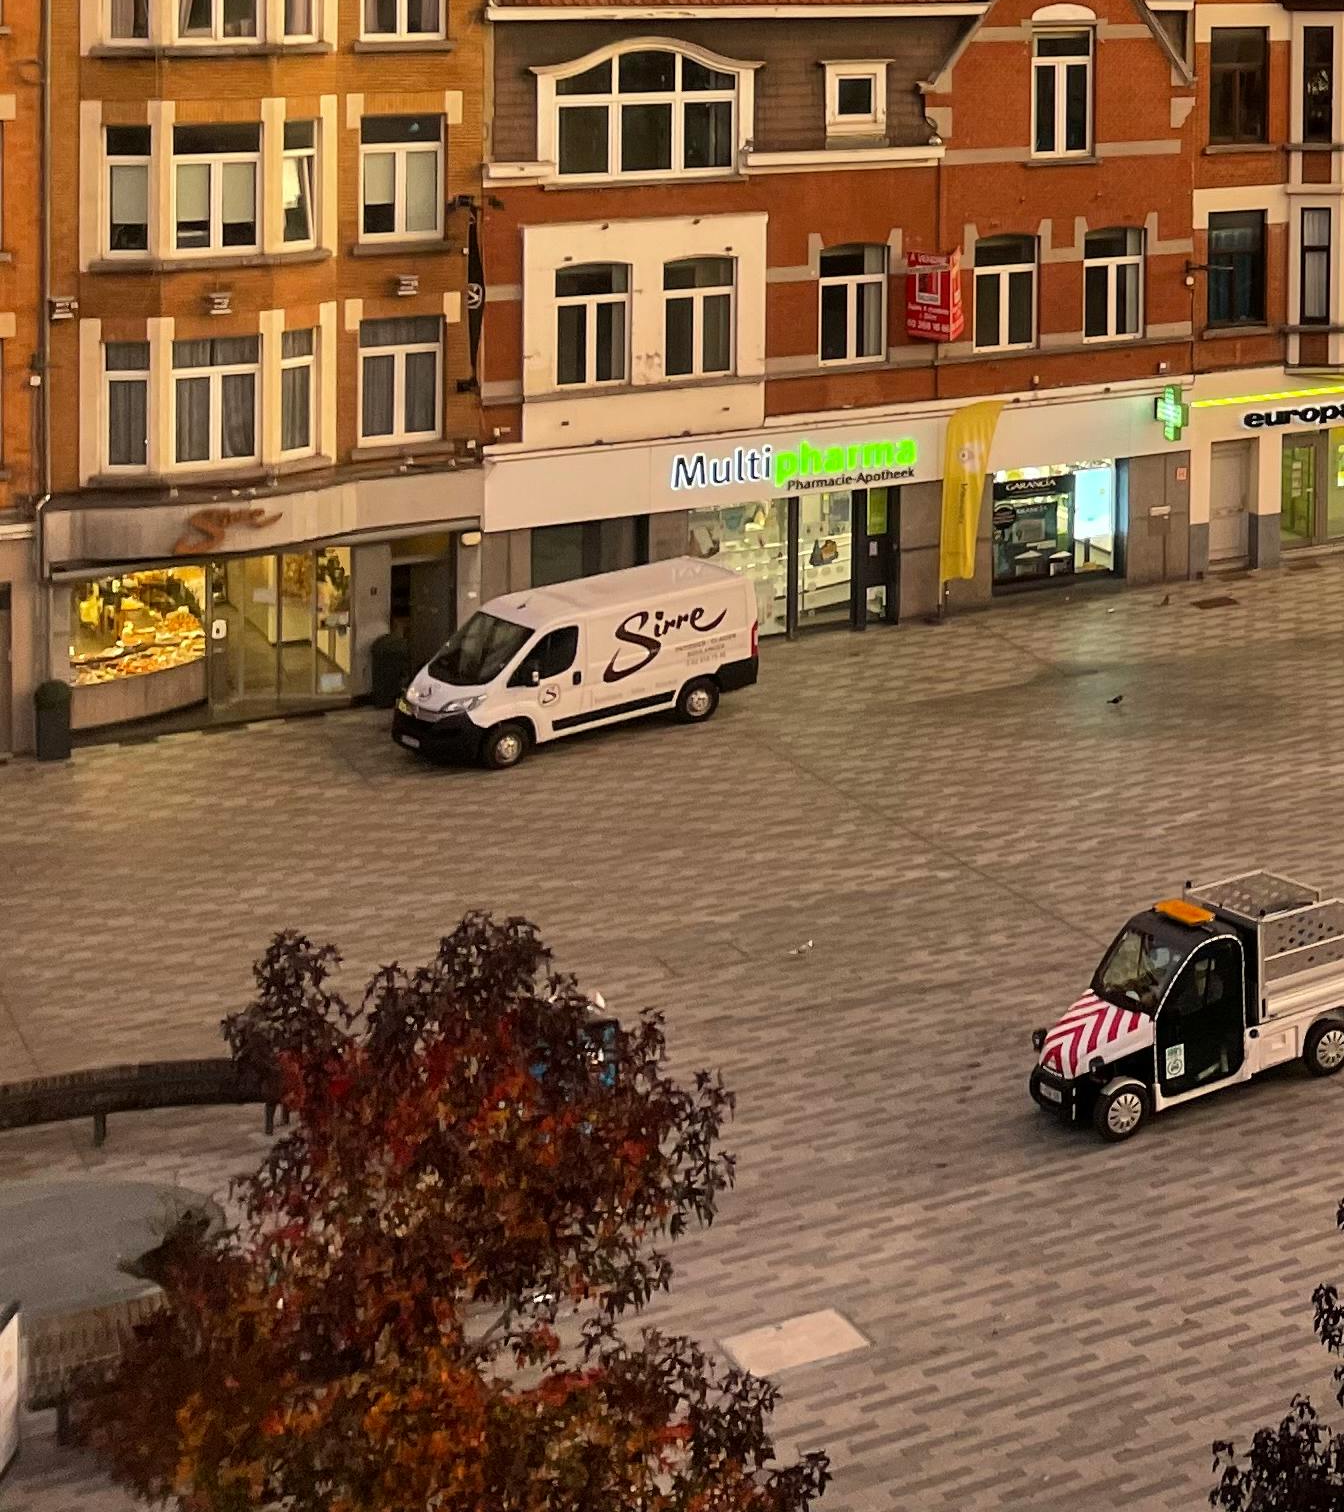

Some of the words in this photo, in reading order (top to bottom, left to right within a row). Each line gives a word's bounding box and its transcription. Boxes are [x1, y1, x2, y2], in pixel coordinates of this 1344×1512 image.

[672, 438, 918, 489] Multipharma
[787, 467, 915, 492] Pharmacie-Apotheek
[1006, 477, 1057, 492] GARANCIA
[603, 607, 728, 683] Sirre
